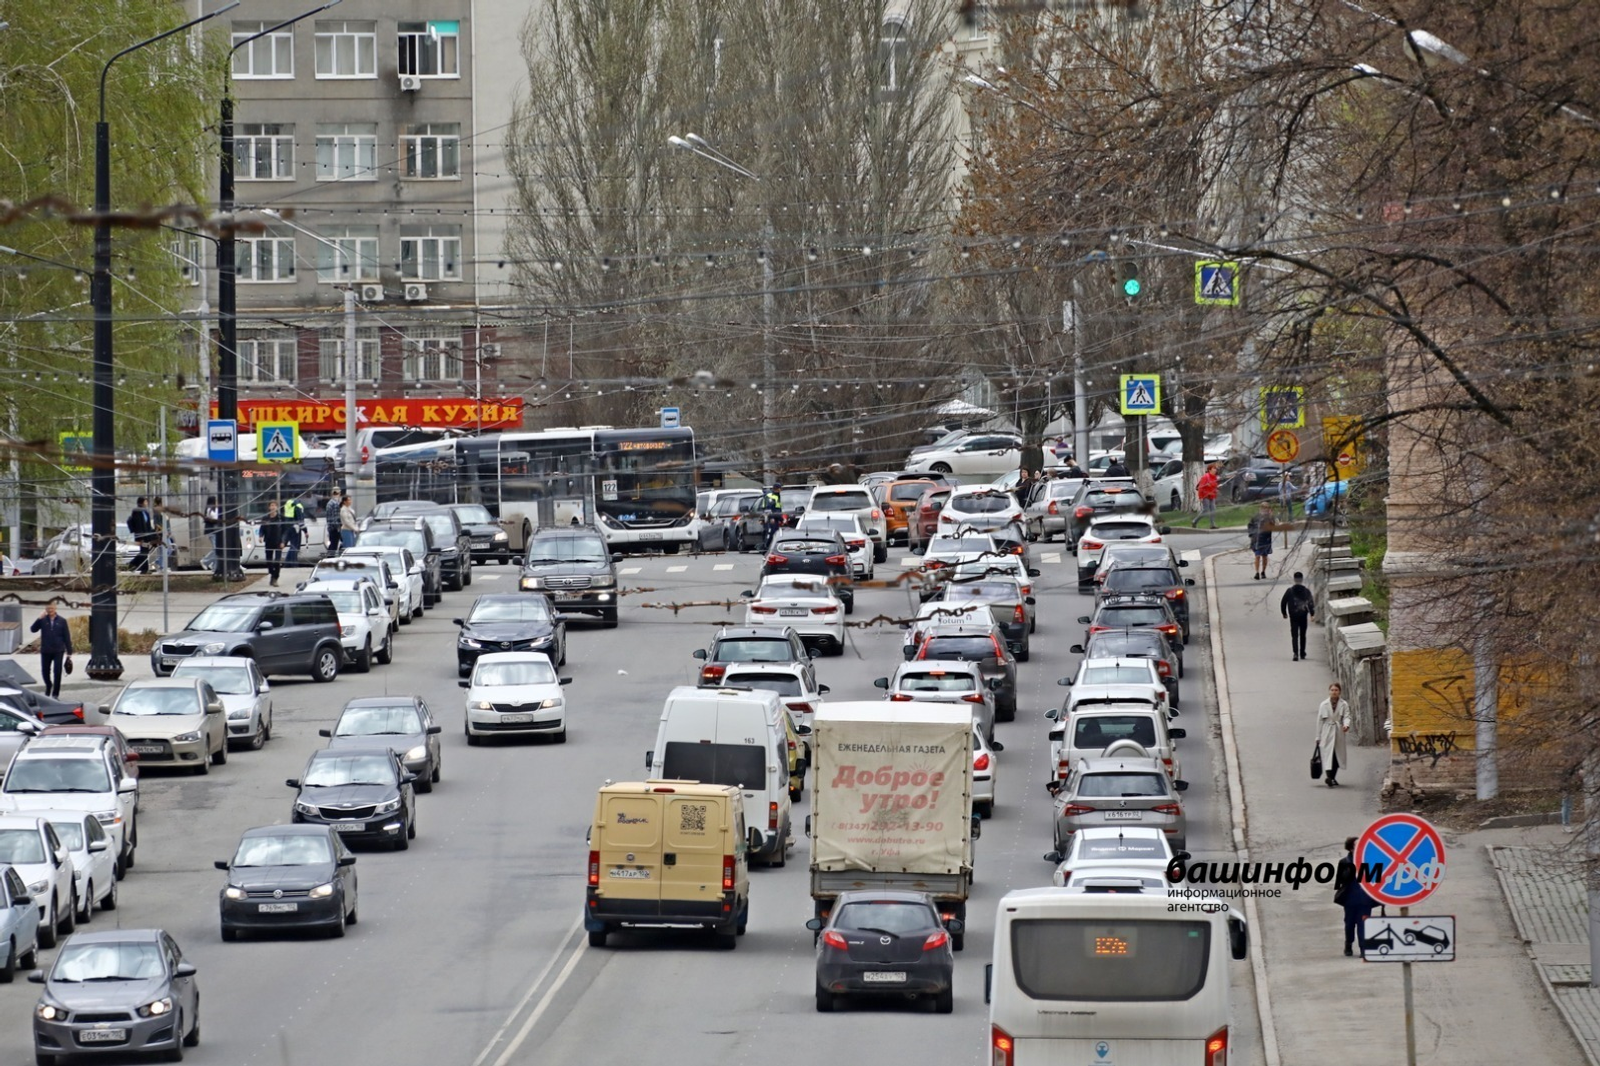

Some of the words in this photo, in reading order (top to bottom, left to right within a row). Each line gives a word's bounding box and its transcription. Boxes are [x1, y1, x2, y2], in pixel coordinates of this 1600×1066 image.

[422, 404, 518, 422] КУХНЯ
[603, 483, 616, 492] 122
[744, 737, 755, 745] 163
[837, 743, 912, 753] ЕЖЕНЕДЕЛЬНАЯ
[913, 745, 946, 754] ГАЗЕТА
[831, 764, 946, 792] Доброе
[858, 790, 940, 815] утро!
